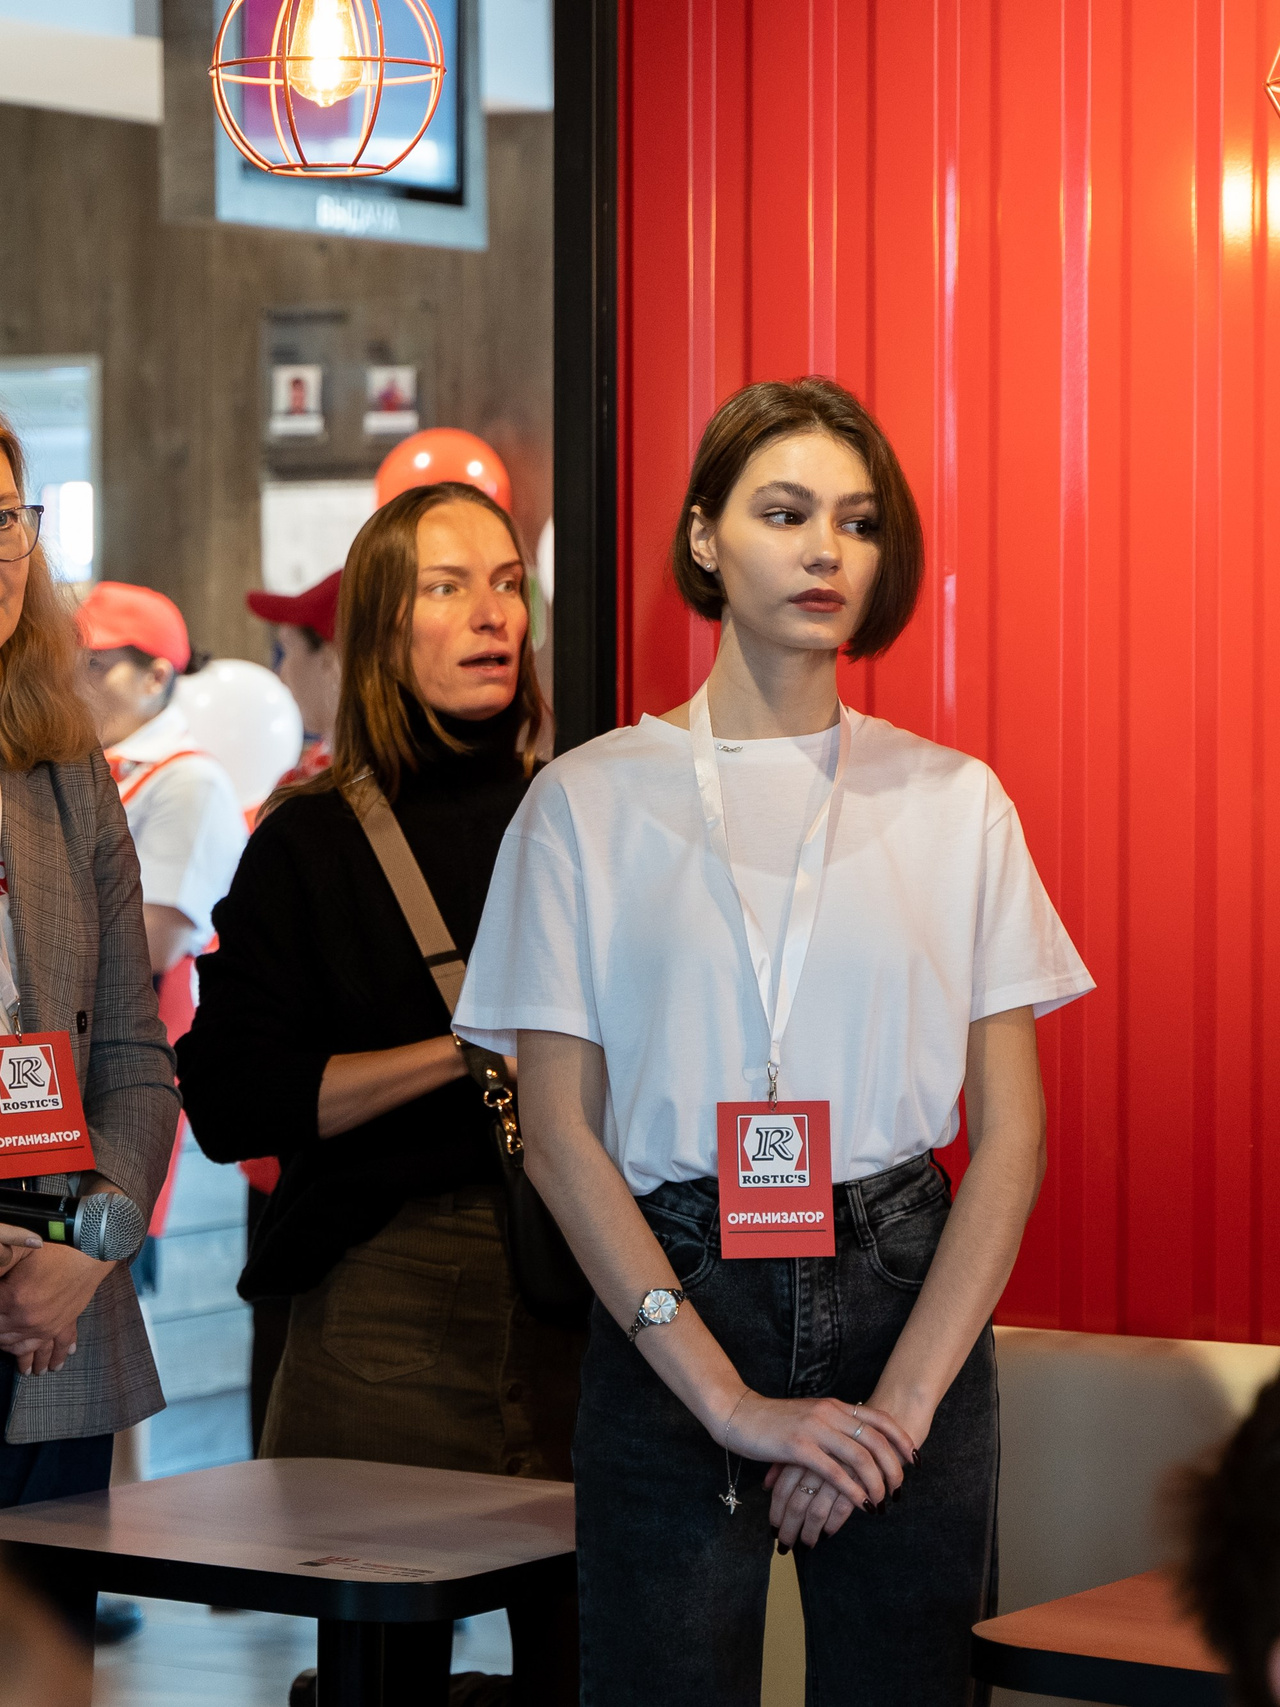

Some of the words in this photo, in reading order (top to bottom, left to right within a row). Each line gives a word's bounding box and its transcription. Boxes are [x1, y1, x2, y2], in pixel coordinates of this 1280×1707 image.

[3, 1098, 59, 1111] ROSTIC'S
[742, 1174, 806, 1184] ROSTIC'S
[727, 1211, 824, 1224] ОРГАНИЗАТОР
